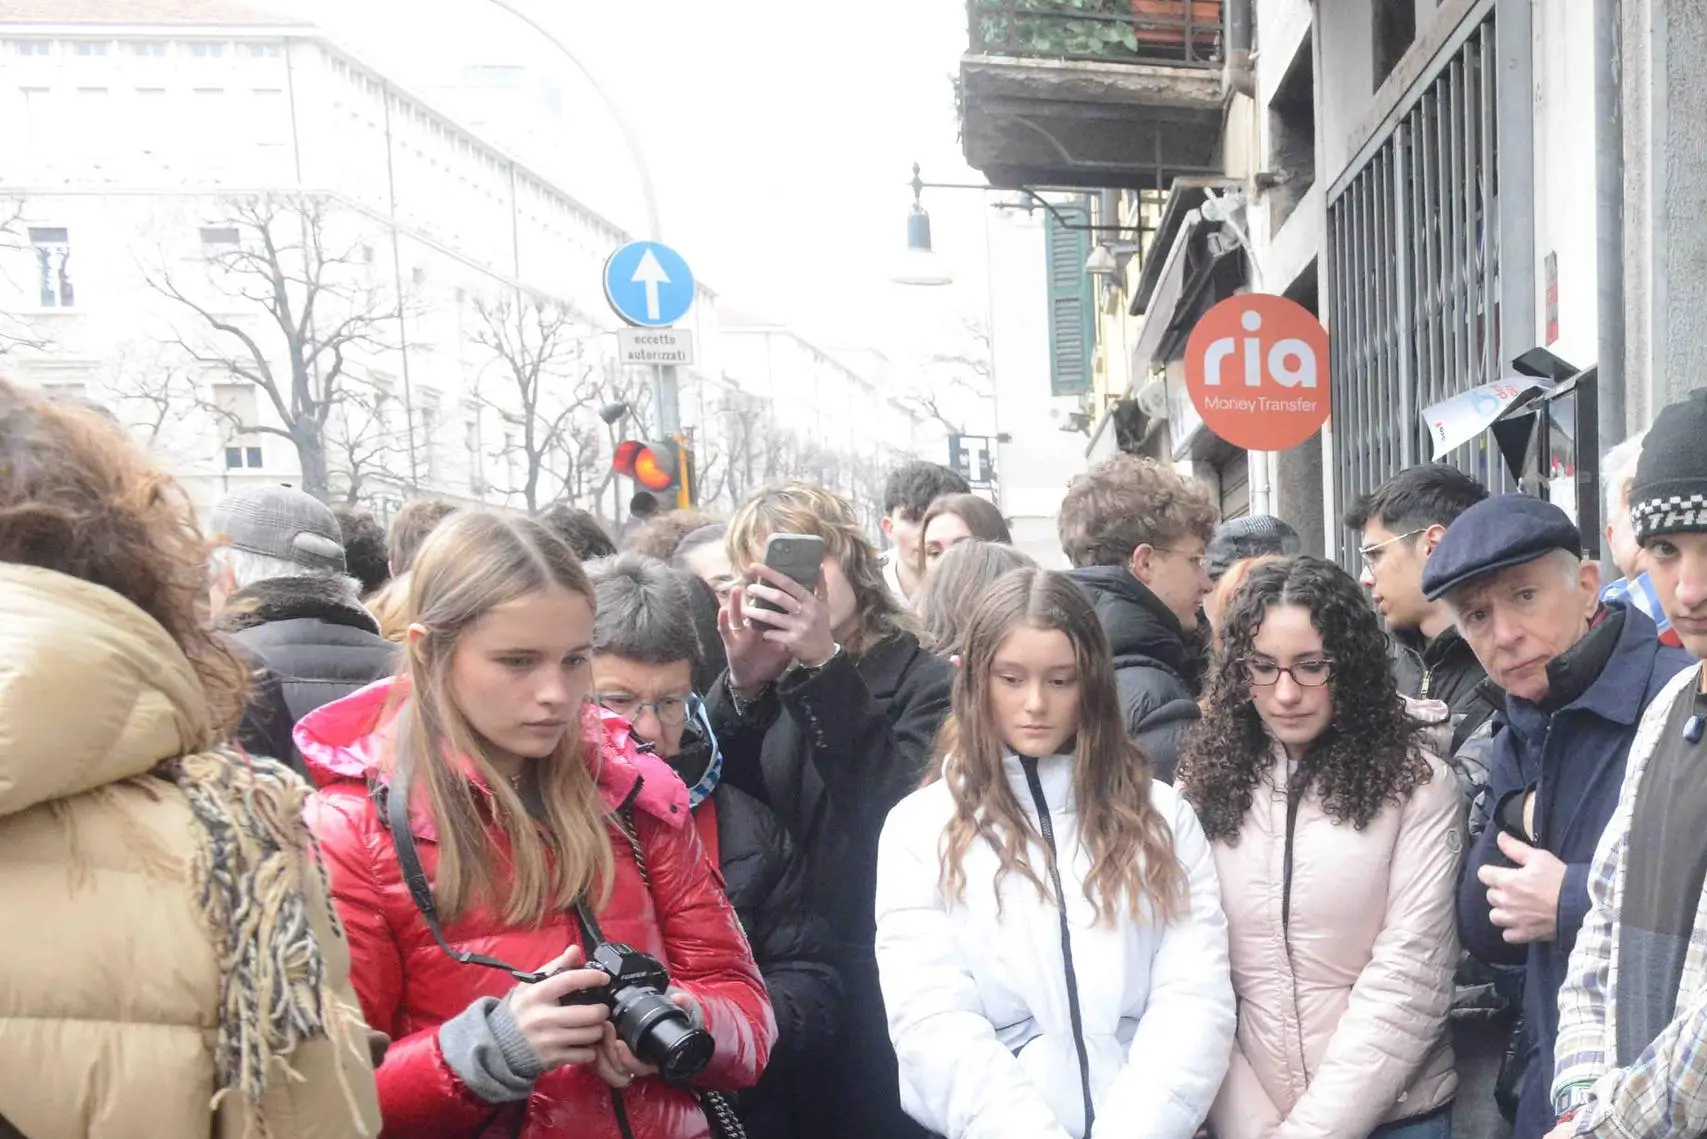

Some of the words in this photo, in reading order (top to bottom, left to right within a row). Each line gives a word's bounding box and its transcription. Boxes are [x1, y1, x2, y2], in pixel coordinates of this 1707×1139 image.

[634, 334, 676, 346] eccetto
[627, 350, 686, 362] autorizzati
[1203, 310, 1318, 388] ria
[1204, 396, 1256, 413] Money
[1257, 396, 1318, 412] Transfer
